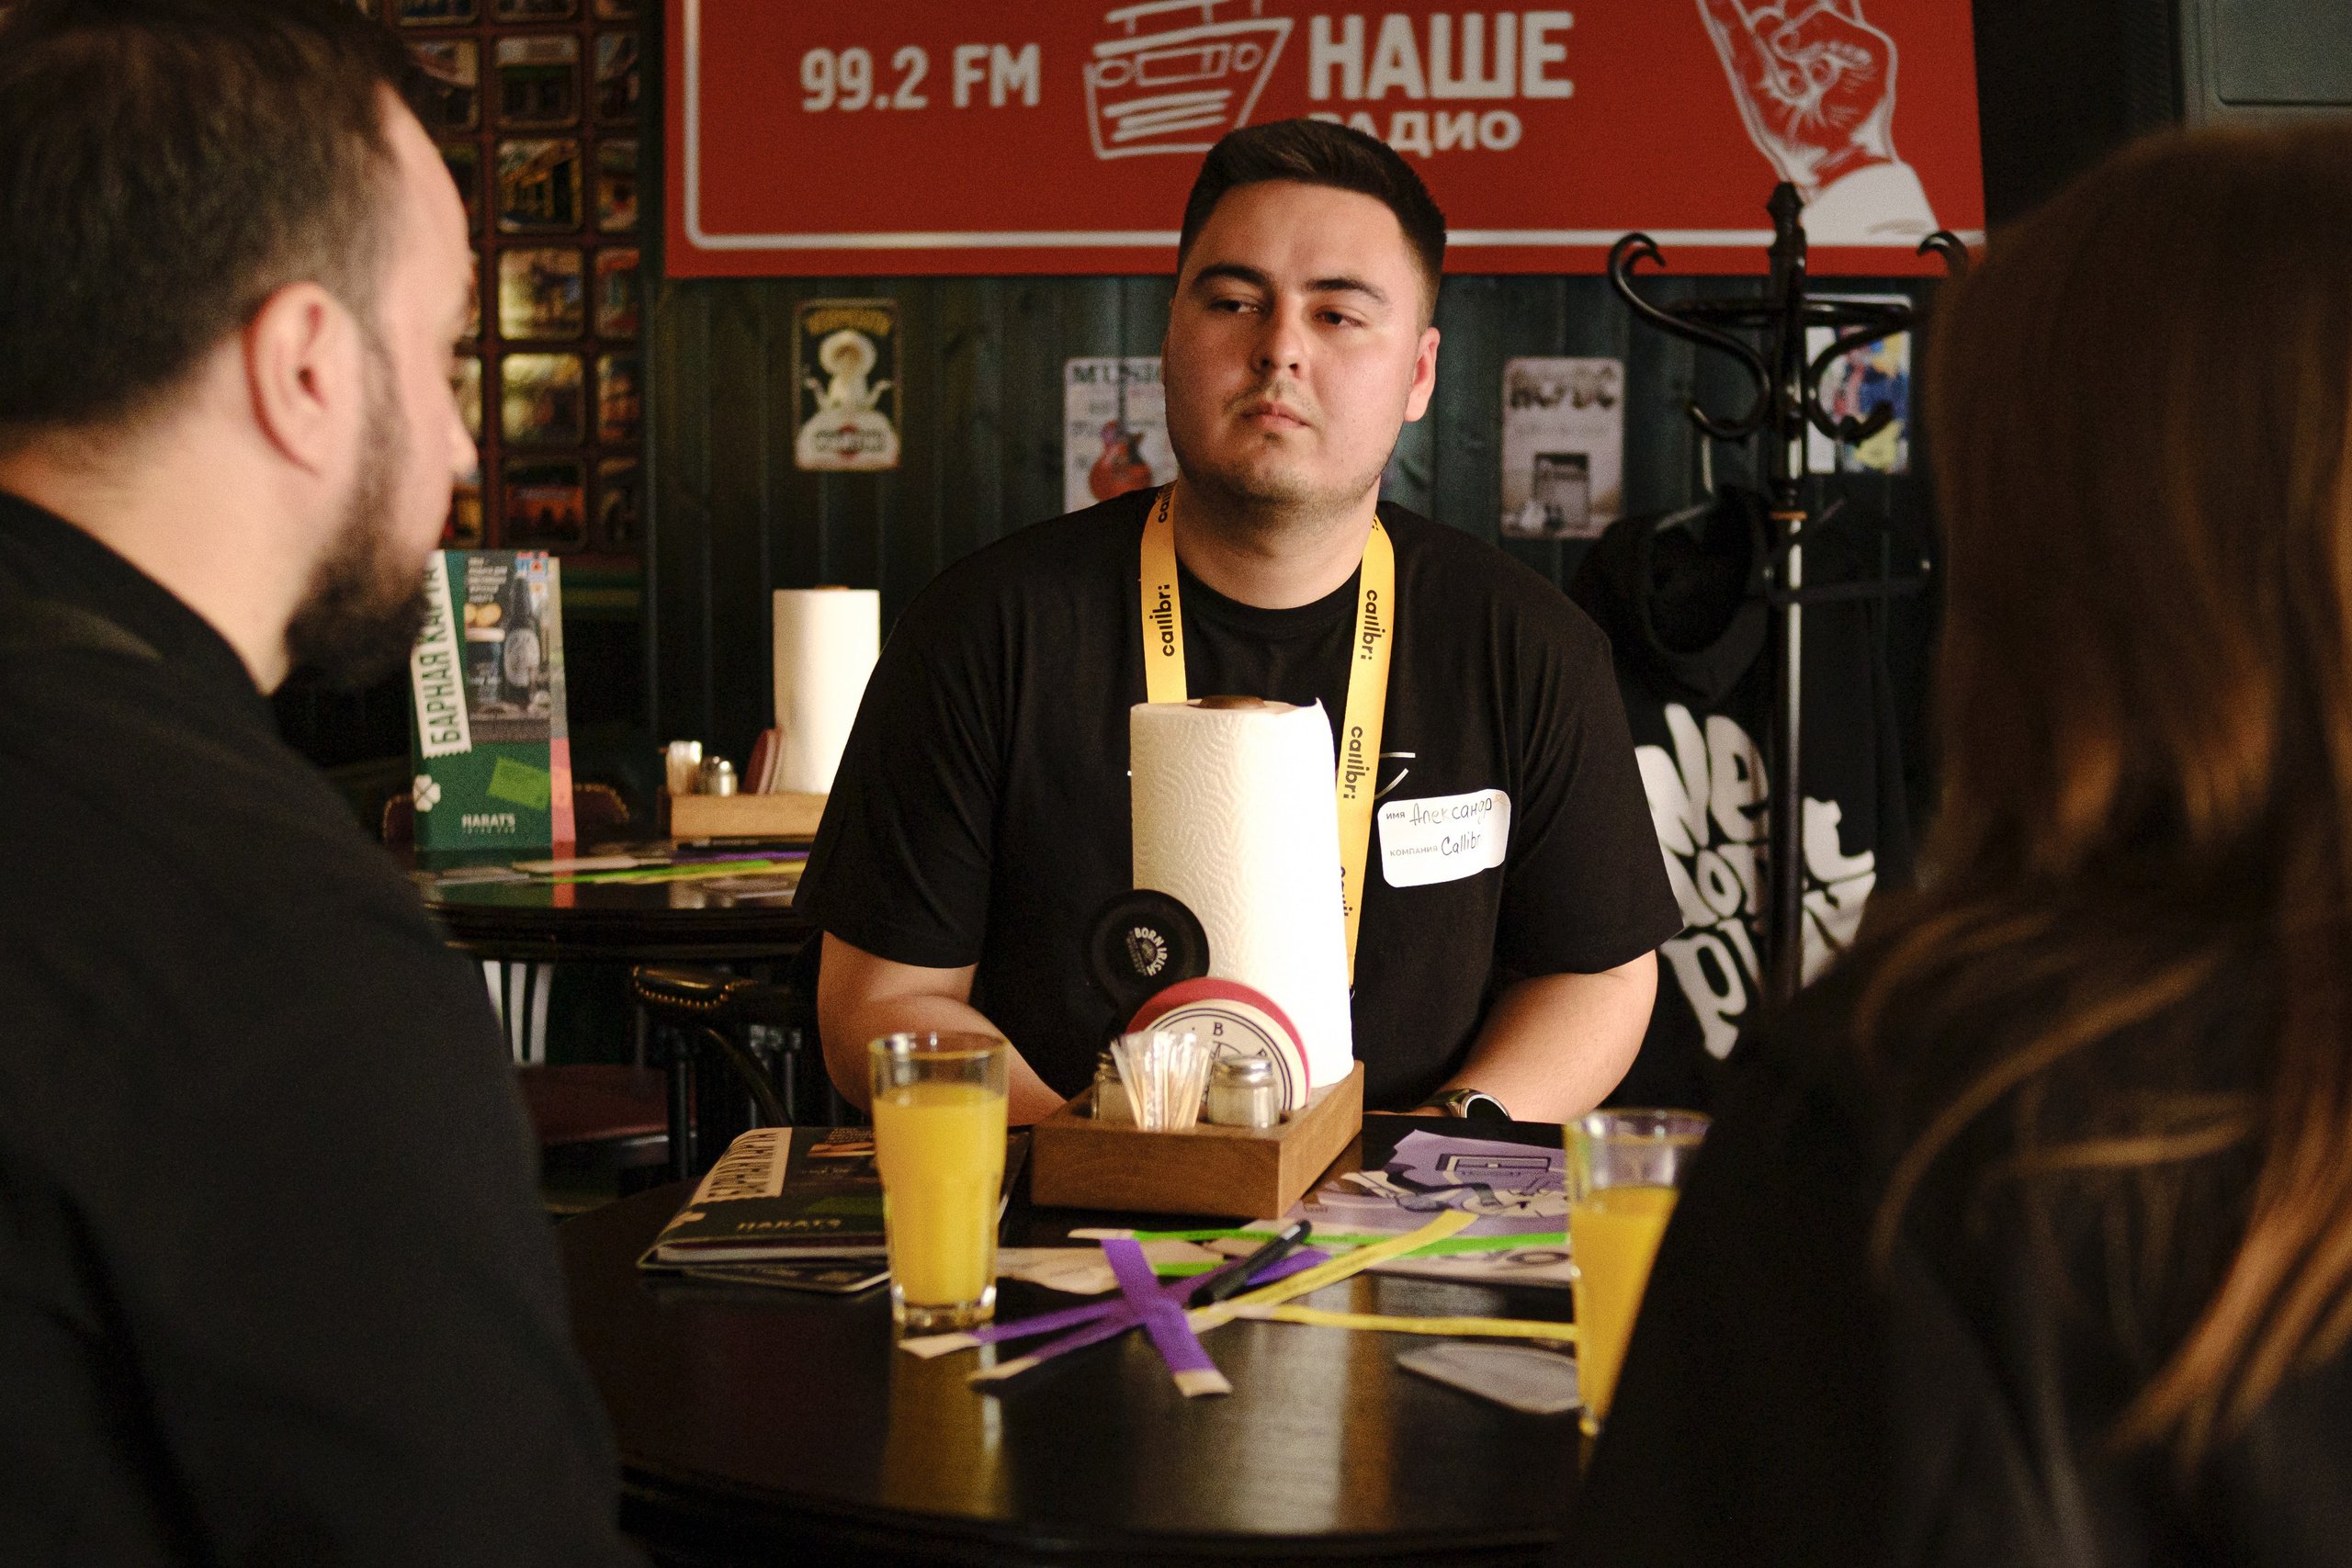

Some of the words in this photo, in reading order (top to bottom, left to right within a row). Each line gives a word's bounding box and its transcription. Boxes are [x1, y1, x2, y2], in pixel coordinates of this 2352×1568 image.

[800, 46, 929, 111] 99.2
[953, 43, 1041, 107] FM
[1308, 11, 1574, 100] НАШЕ
[1307, 110, 1522, 158] АДИО
[420, 650, 461, 745] БАРНАЯ
[1134, 927, 1165, 948] BORN
[1146, 947, 1168, 976] IRISH
